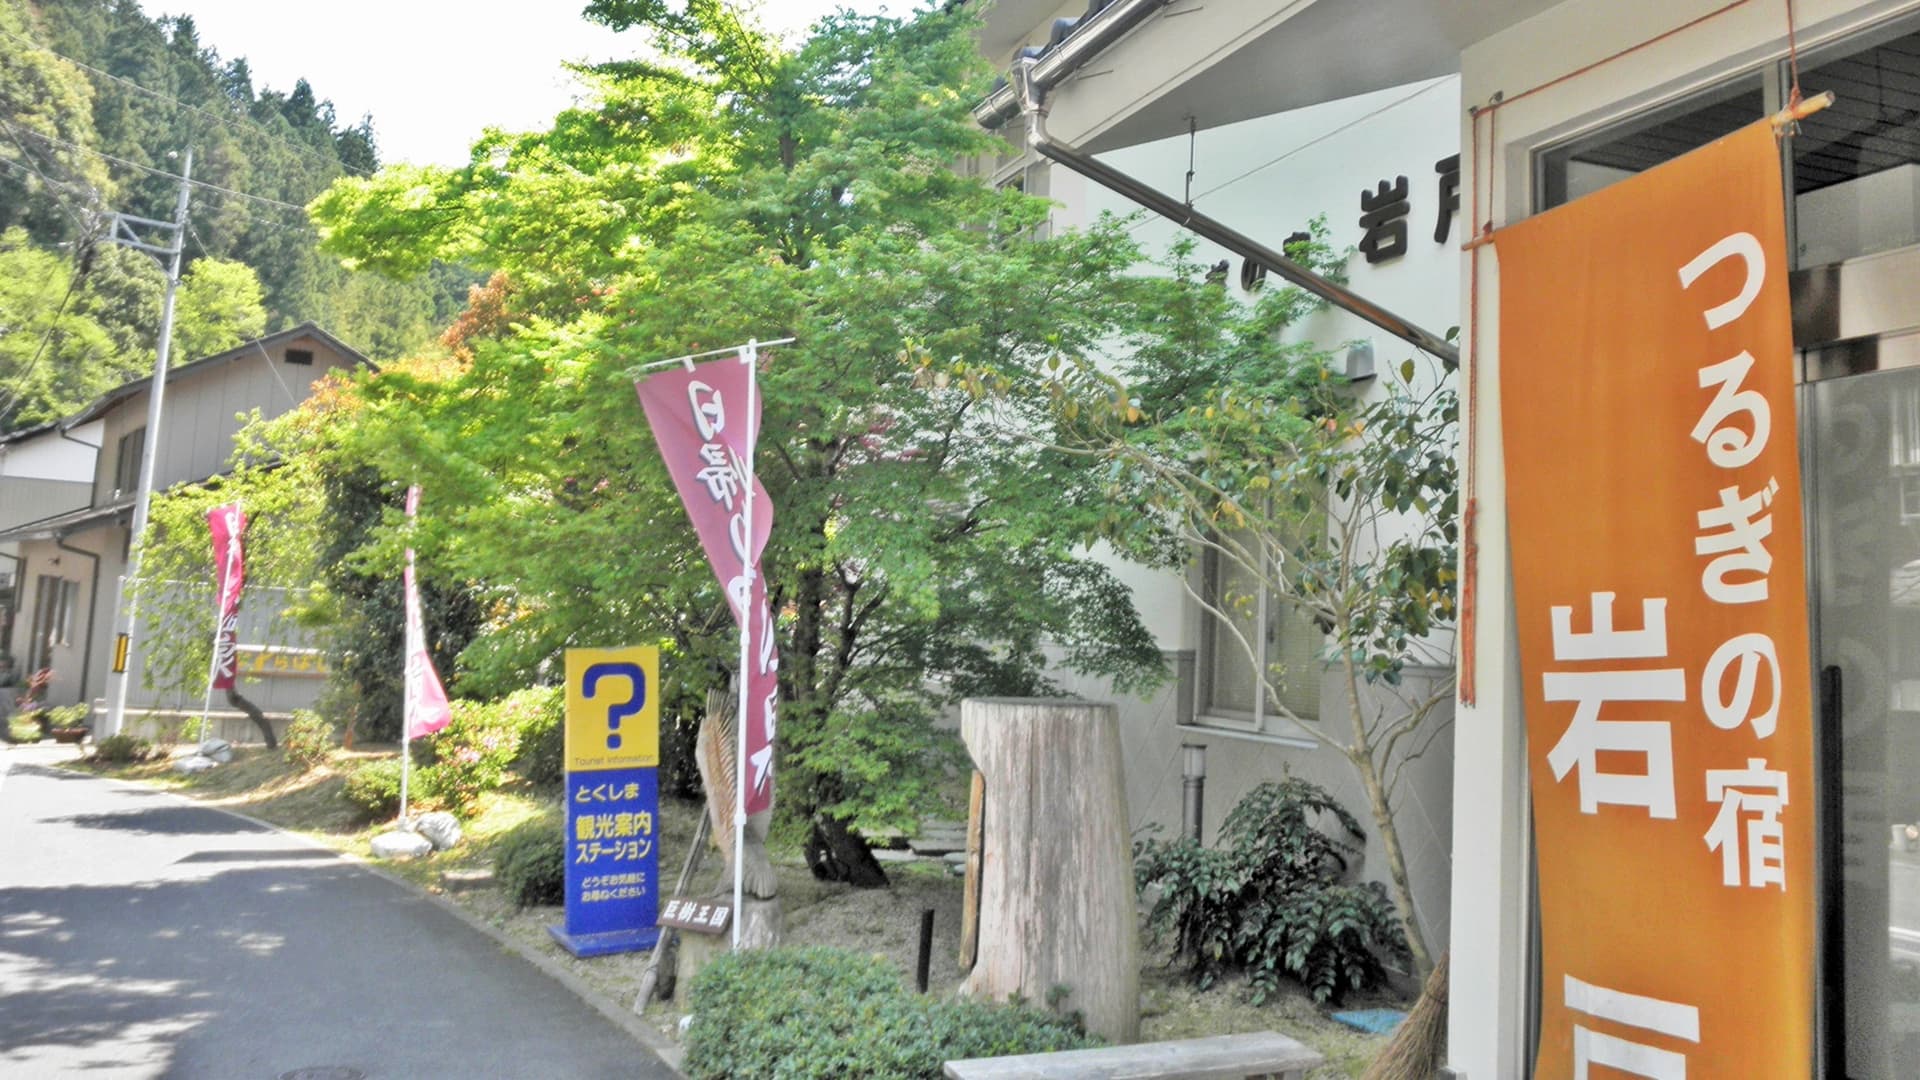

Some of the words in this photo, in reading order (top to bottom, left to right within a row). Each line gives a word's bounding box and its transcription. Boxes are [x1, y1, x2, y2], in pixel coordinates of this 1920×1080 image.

[1677, 231, 1791, 892] つるぎの宿
[574, 783, 640, 803] とくしま
[575, 811, 653, 841] 観光案内
[575, 839, 653, 865] ステーション
[663, 900, 729, 927] 巨樹王国
